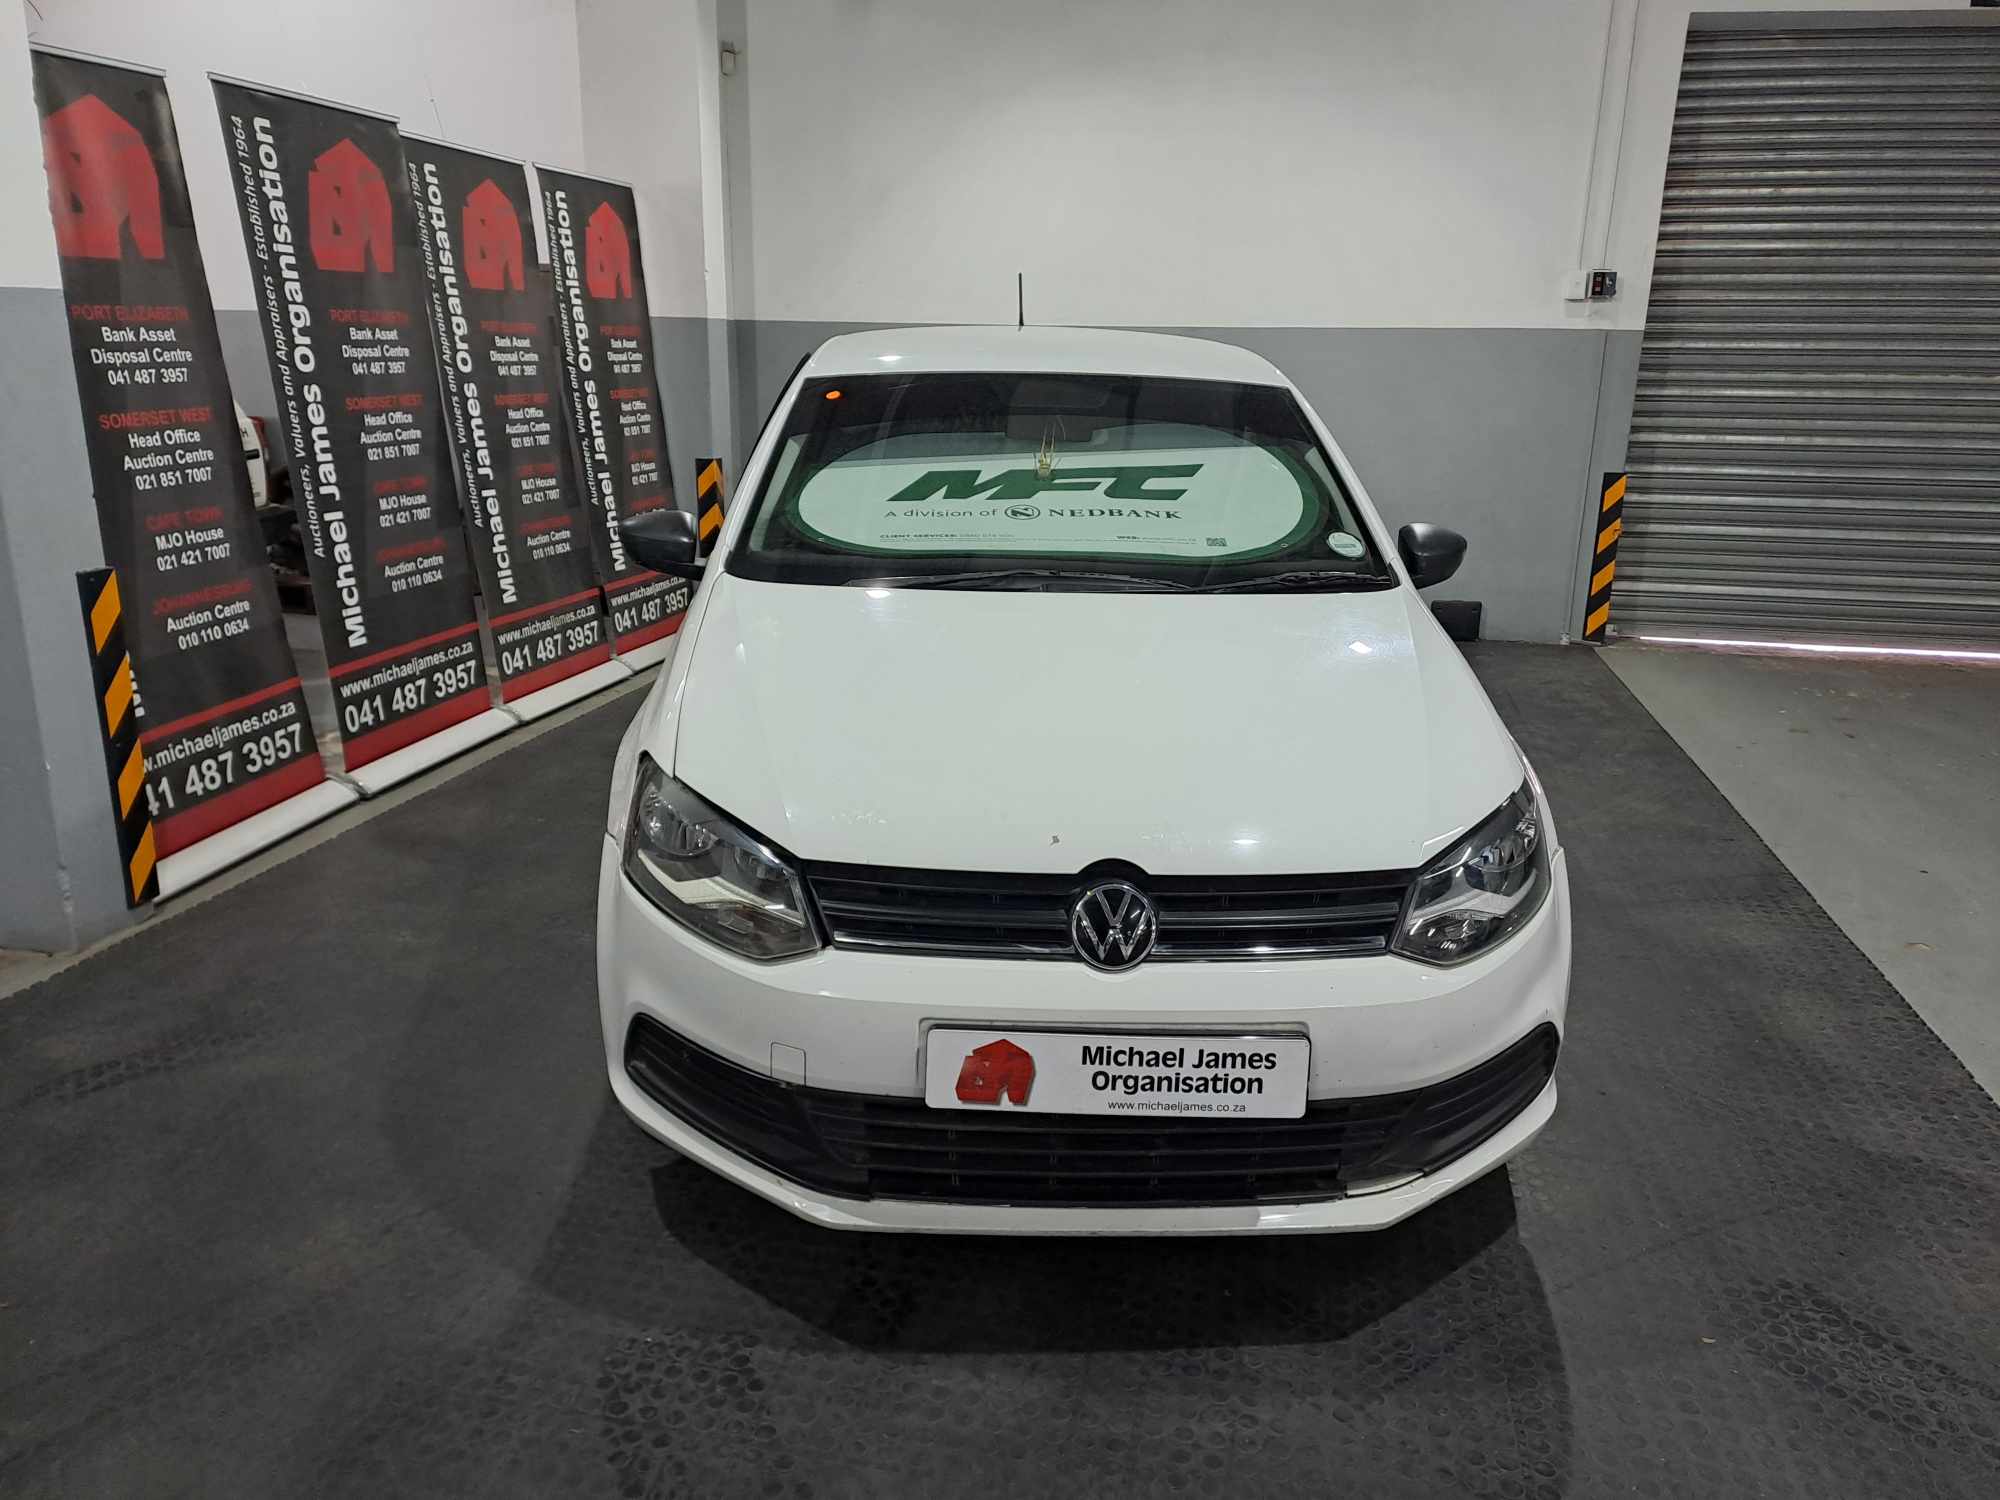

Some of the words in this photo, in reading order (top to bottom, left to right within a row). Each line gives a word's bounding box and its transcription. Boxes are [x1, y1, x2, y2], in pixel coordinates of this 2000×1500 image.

[230, 114, 250, 159] 1964
[239, 160, 269, 260] Established
[253, 116, 316, 374] Organisation
[415, 200, 436, 281] Established
[423, 162, 472, 374] Organisation
[555, 190, 592, 372] Organisation
[101, 326, 136, 342] Bank
[139, 327, 176, 342] Asset
[263, 274, 289, 362] Appraisers
[350, 327, 372, 340] Bank
[374, 328, 399, 341] Asset
[432, 291, 453, 363] Appraisers
[90, 347, 150, 366] Disposal
[153, 347, 193, 363] Centre
[342, 345, 381, 360] Disposal
[383, 345, 410, 357] Centre
[352, 362, 368, 375] 041
[107, 369, 131, 386] 041
[134, 369, 156, 384] 487
[161, 367, 188, 384] 3957
[281, 364, 294, 396] and
[448, 365, 457, 393] and
[99, 408, 177, 429] SOMERSET
[287, 399, 307, 458] Valuers
[363, 413, 387, 427] Head
[388, 411, 412, 425] Office
[452, 395, 468, 444] Valuers
[464, 382, 493, 480] James
[584, 379, 607, 464] James
[128, 430, 161, 449] Head
[164, 429, 201, 445] Office
[303, 383, 341, 501] James
[360, 431, 393, 444] Auction
[395, 428, 421, 441] Centre
[123, 452, 173, 471] Auction
[175, 448, 214, 465] Centre
[367, 448, 382, 461] 021
[135, 474, 157, 490] 021
[160, 471, 183, 488] 851
[185, 467, 212, 484] 7007
[300, 464, 325, 558] Auctioneers,
[400, 494, 427, 507] House
[903, 509, 973, 517] division
[979, 508, 1000, 516] of
[1049, 508, 1184, 519] NEDBANK
[379, 514, 394, 528] 021
[396, 511, 411, 525] 421
[598, 472, 626, 571] Michael
[155, 532, 183, 551] MJO
[185, 527, 224, 545] House
[482, 489, 517, 604] Michael
[156, 554, 178, 571] 021
[181, 550, 202, 567] 421
[205, 543, 231, 561] 7007
[384, 562, 416, 577] Auction
[417, 555, 444, 571] Centre
[323, 510, 368, 649] Michael
[167, 609, 212, 633] Auction
[214, 600, 250, 620] Centre
[498, 605, 596, 645] www.michaeljames.co.za
[614, 607, 638, 632] 041
[641, 599, 661, 622] 487
[664, 587, 688, 613] 3957
[178, 633, 199, 650] 010
[201, 626, 222, 644] 110
[224, 618, 250, 637] 0634
[502, 644, 532, 675] 041
[536, 633, 562, 661] 487
[566, 620, 599, 651] 3957
[340, 641, 473, 698] www.michaeljames.co.za
[344, 694, 385, 733] 041
[392, 678, 427, 713] 487
[432, 660, 476, 698] 3957
[143, 701, 296, 773] w.michaeljames.co.za
[185, 750, 235, 797] 487
[242, 722, 301, 773] 3957
[1081, 1044, 1185, 1069] Michael
[1191, 1047, 1277, 1071] James
[1091, 1070, 1264, 1095] Organisation
[1107, 1099, 1247, 1114] www.michaeljames.co.za
